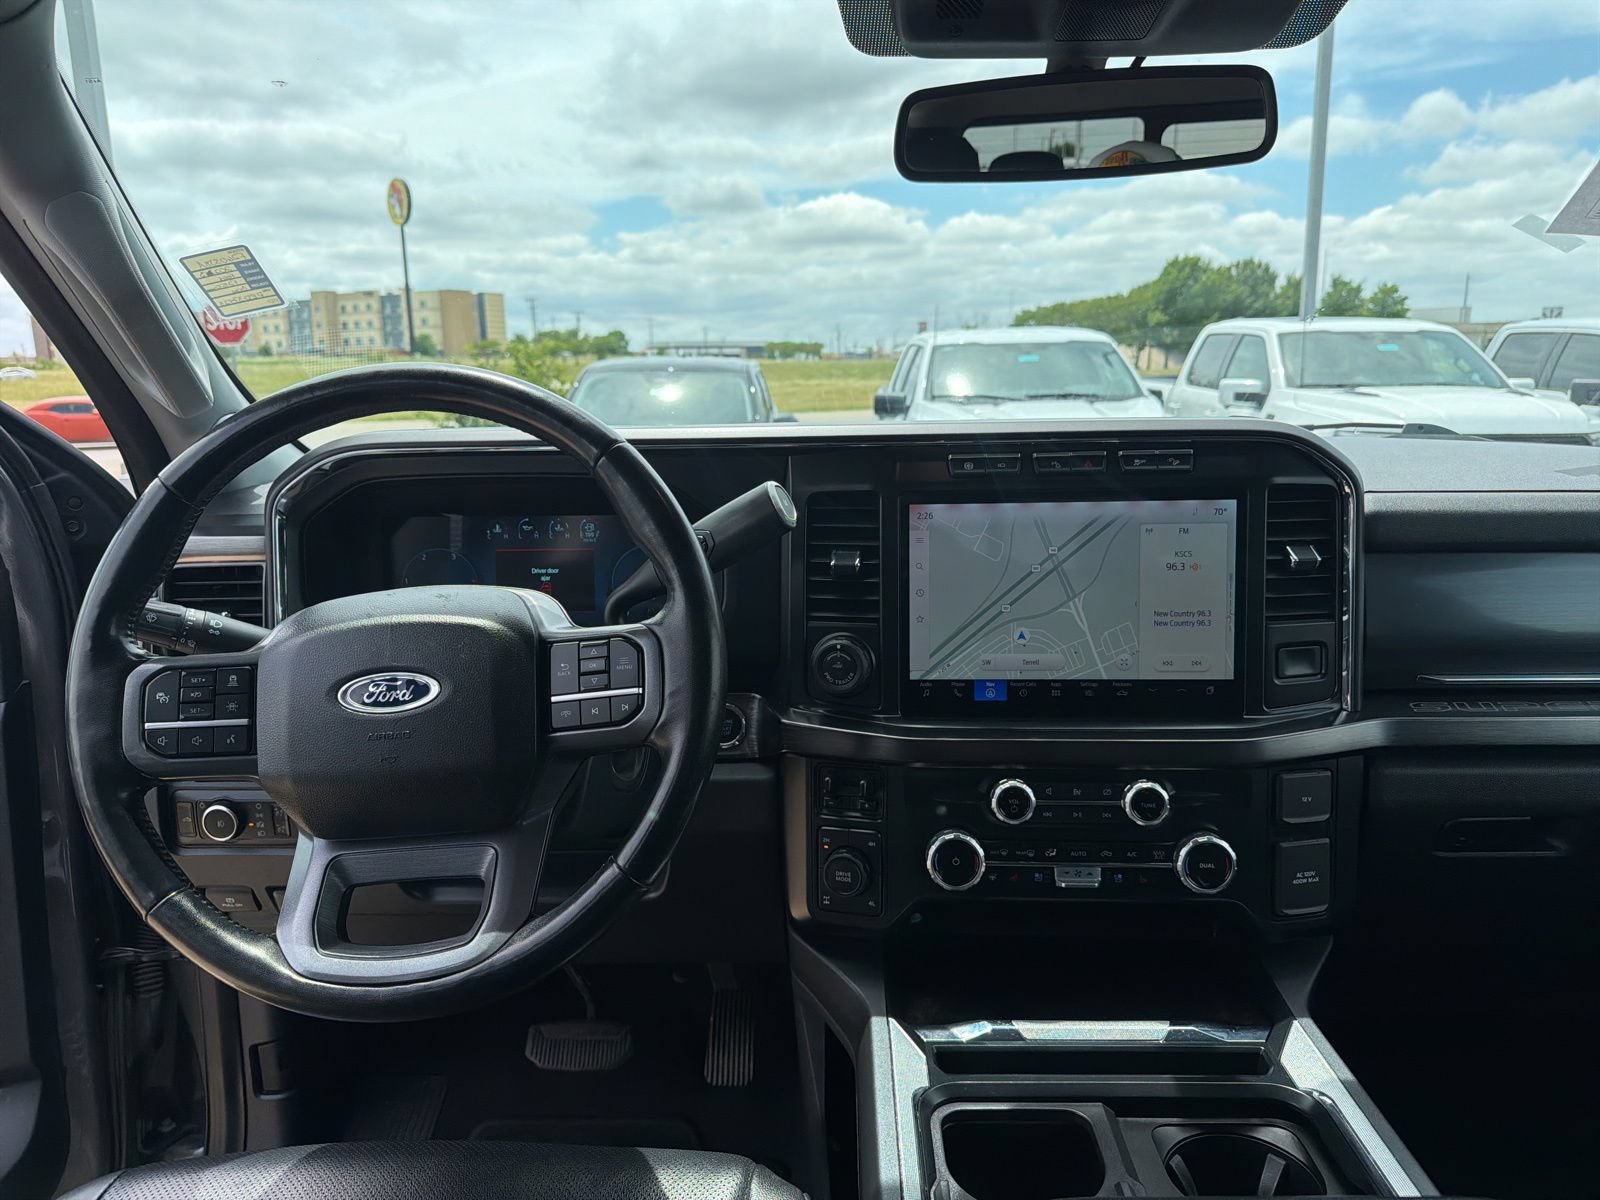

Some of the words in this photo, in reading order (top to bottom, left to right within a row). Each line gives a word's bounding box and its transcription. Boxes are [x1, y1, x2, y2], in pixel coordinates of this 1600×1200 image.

[916, 512, 934, 520] 2:26
[1178, 527, 1189, 535] FM
[1174, 550, 1193, 558] KSCS
[1165, 562, 1185, 571] 96.3
[1169, 610, 1195, 618] Country
[1169, 620, 1195, 628] Country
[1196, 619, 1211, 627] 96.3
[363, 680, 415, 704] Ford
[367, 730, 412, 741] AIRBAG
